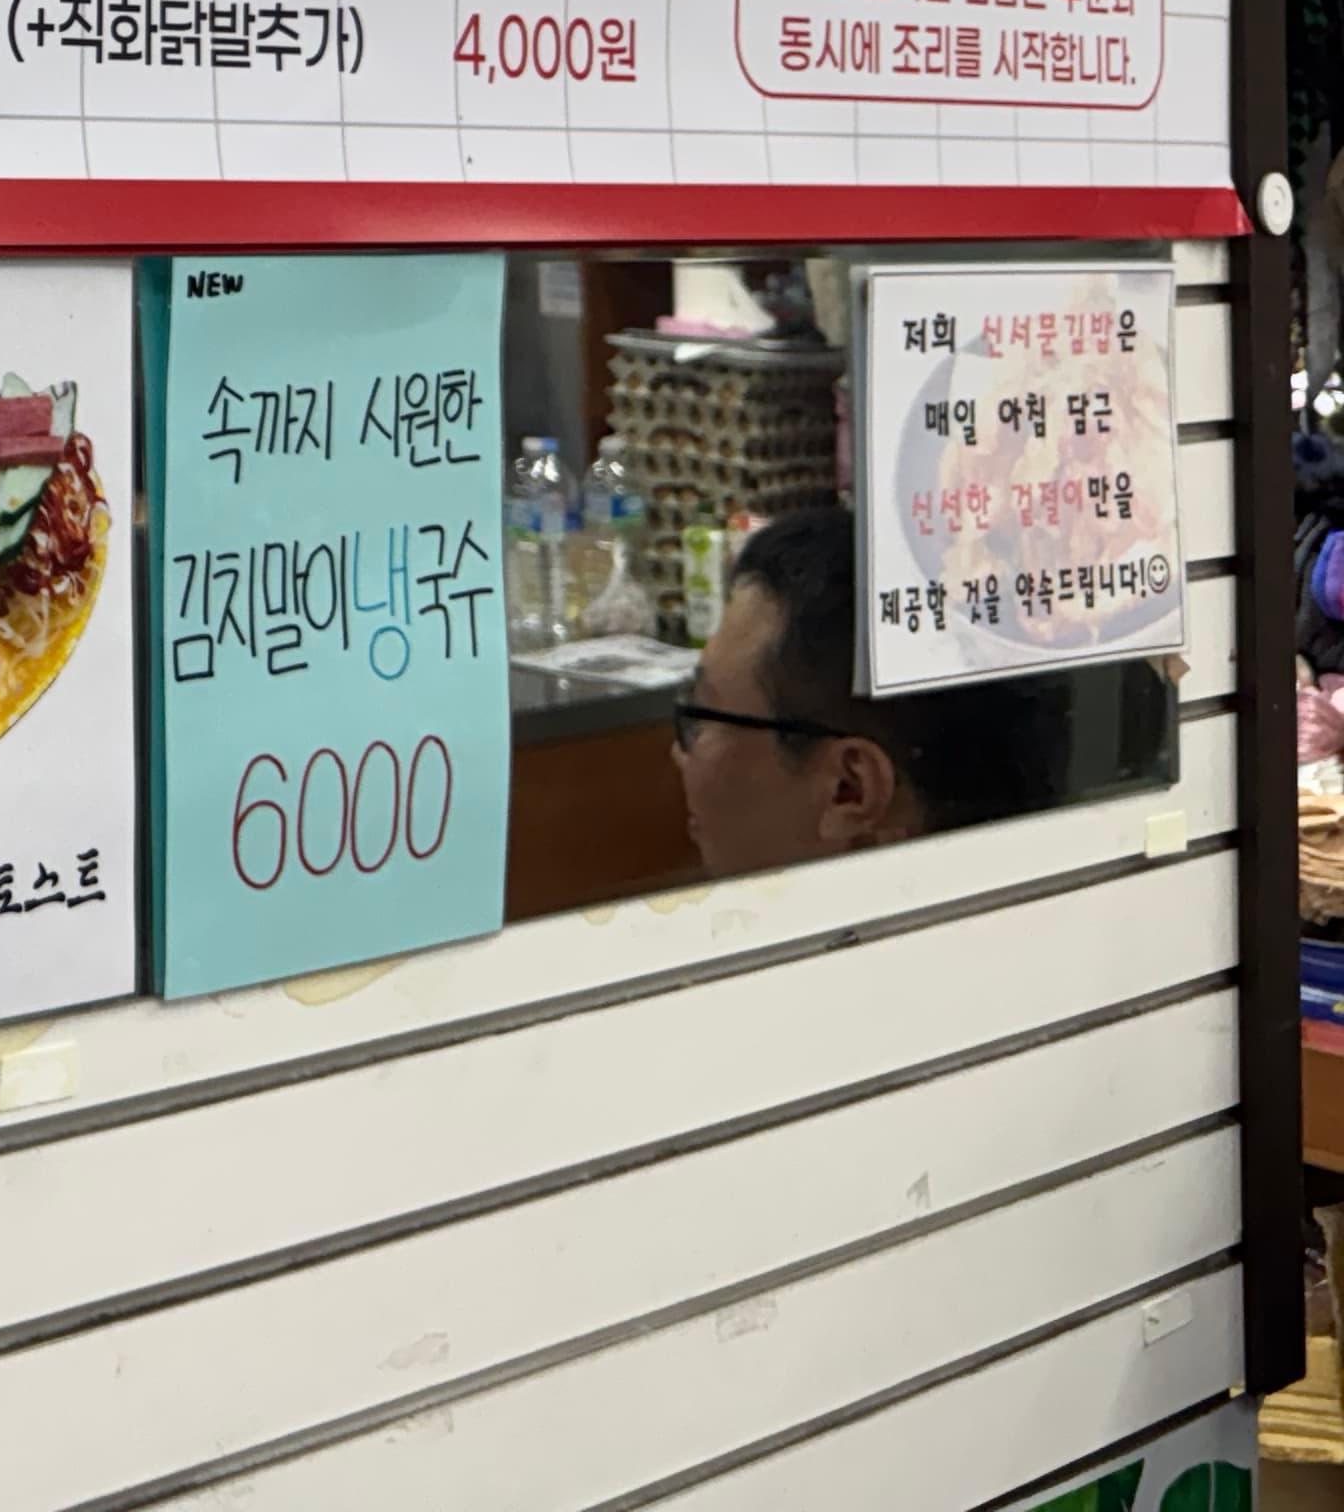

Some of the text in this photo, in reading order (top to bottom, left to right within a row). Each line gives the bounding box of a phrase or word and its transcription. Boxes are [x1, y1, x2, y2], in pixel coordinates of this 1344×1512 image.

[453, 13, 639, 84] 4,000원
[778, 17, 1137, 86] 동시에 조리를 시작합니다.
[187, 271, 244, 300] NEW
[903, 312, 957, 354] 저희
[203, 368, 483, 485] 속까지 시원한
[925, 392, 1113, 447] 매일 아침 담근
[879, 558, 1147, 633] 제공할 것을 약속드립니다!
[232, 734, 453, 890] 6000
